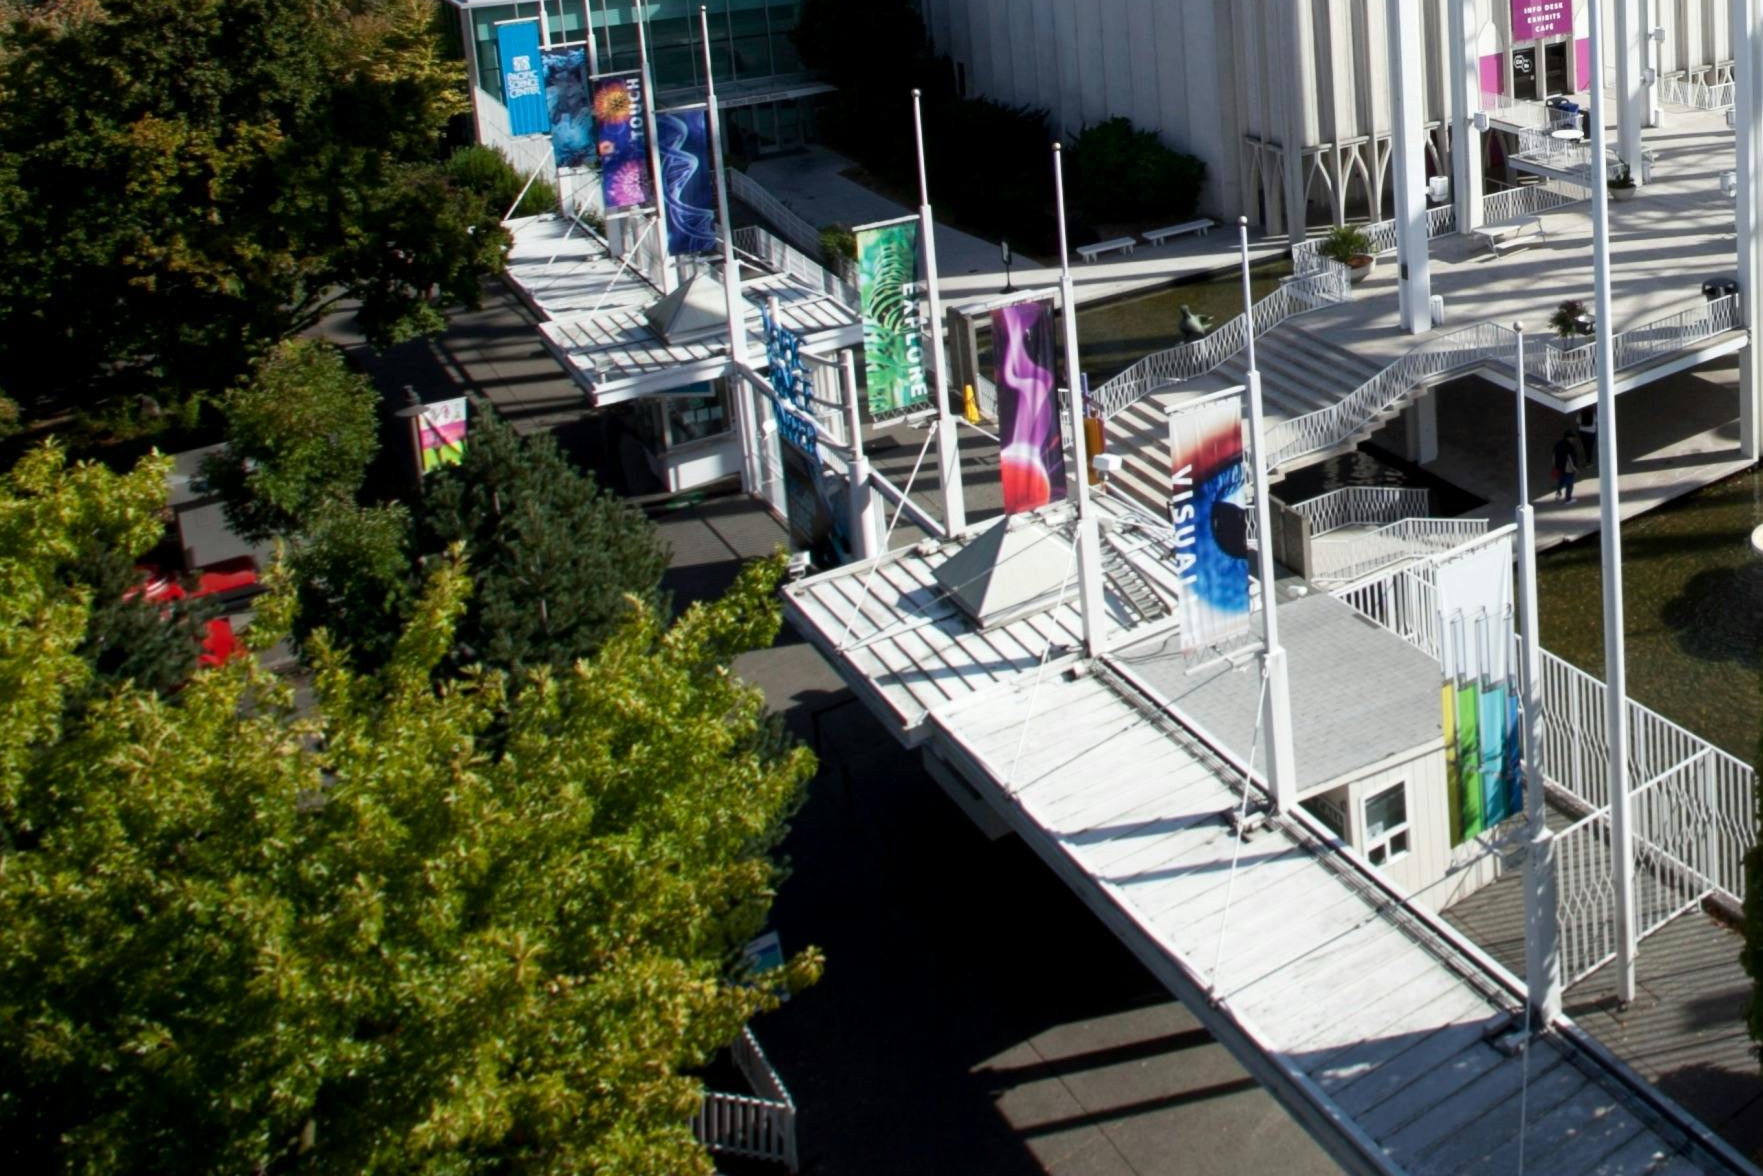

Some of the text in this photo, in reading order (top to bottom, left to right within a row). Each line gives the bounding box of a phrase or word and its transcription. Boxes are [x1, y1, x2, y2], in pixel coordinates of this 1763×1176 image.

[1524, 2, 1563, 14] INFO DESK
[1527, 13, 1561, 24] EXHIBITS
[1535, 23, 1554, 32] CAFÉ
[626, 77, 643, 141] TOUCH
[902, 282, 928, 398] EXPLORE
